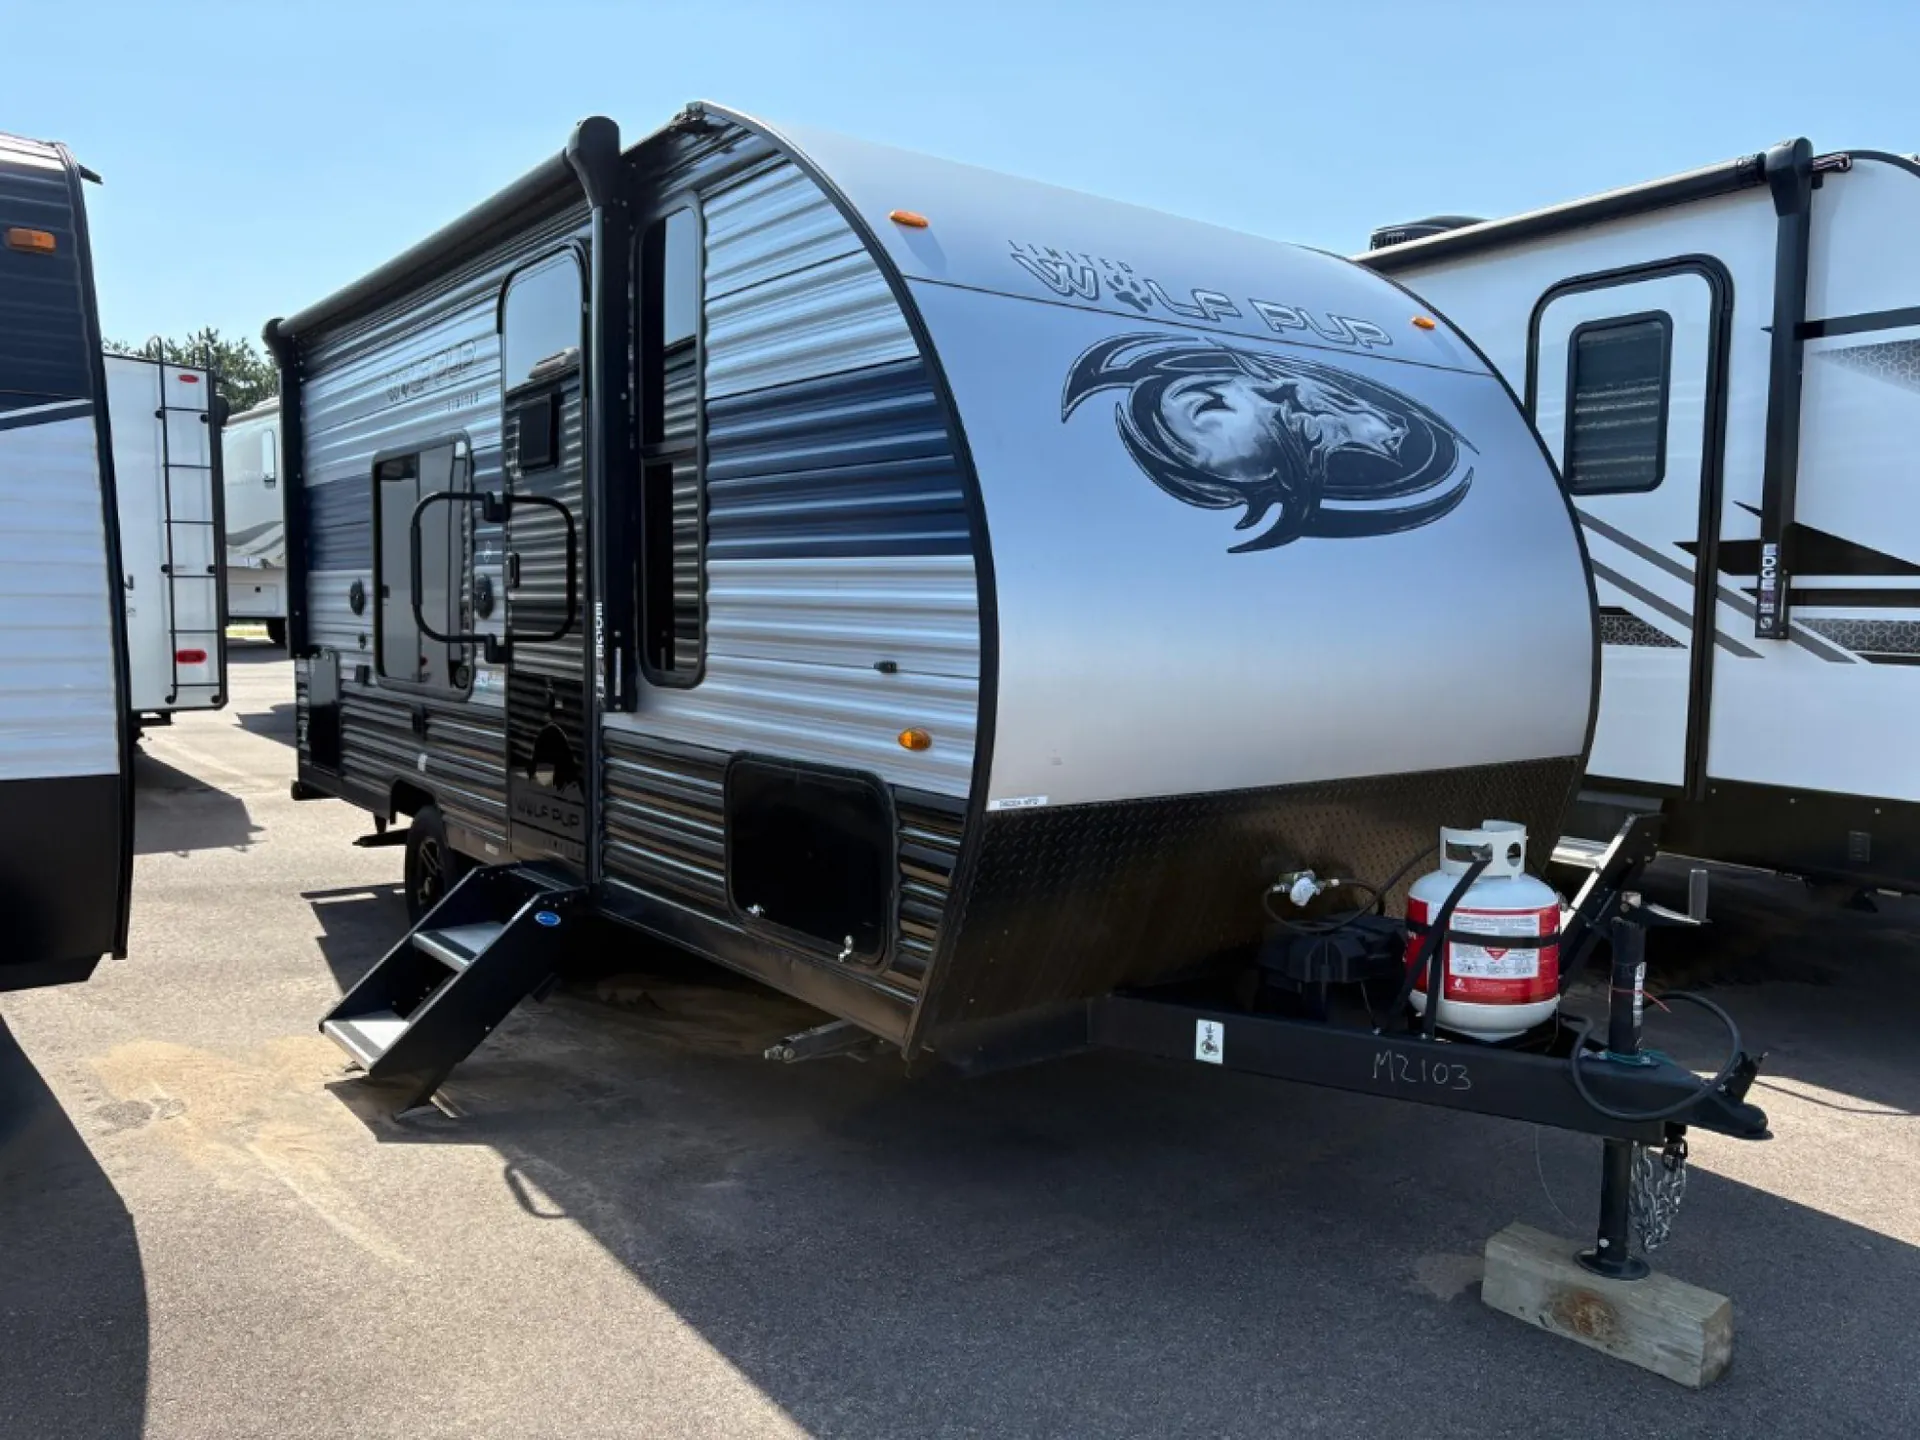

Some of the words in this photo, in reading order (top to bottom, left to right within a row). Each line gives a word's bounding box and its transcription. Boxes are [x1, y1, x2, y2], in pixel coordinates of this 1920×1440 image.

[1008, 239, 1133, 273] LIMITED
[1248, 298, 1393, 349] PUP
[1372, 1049, 1472, 1091] M2103
